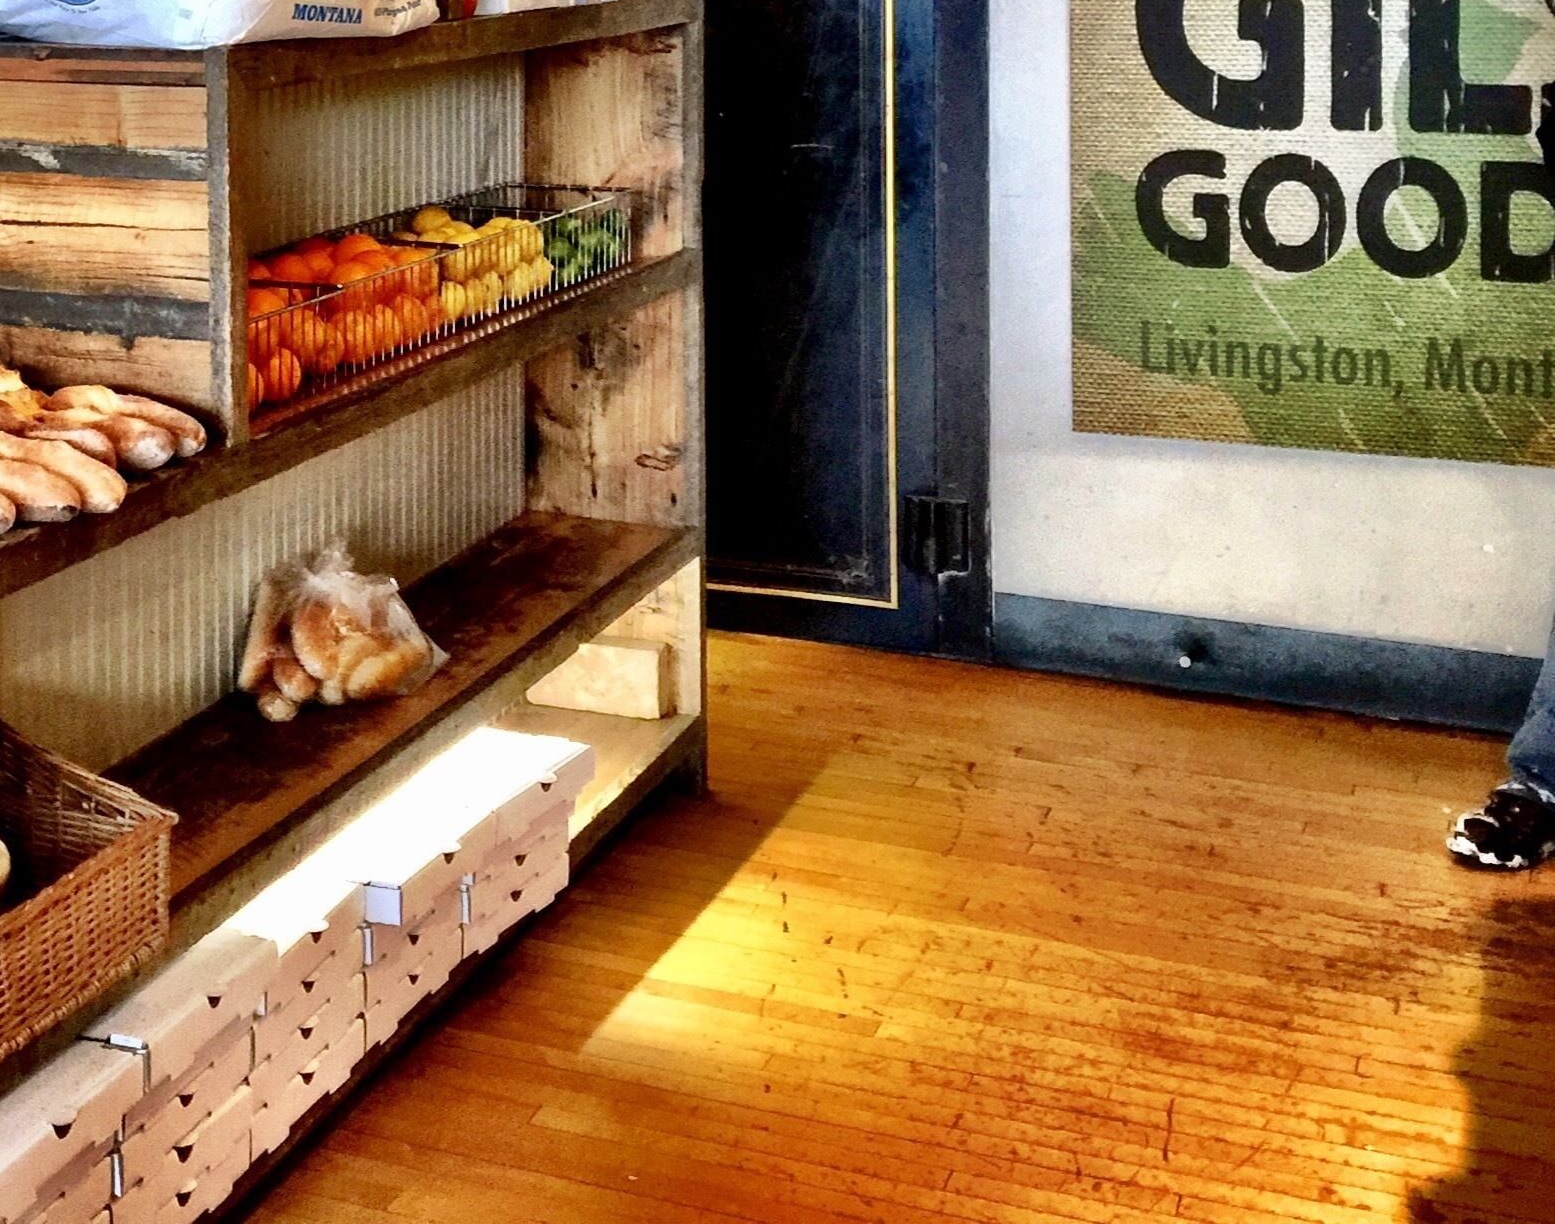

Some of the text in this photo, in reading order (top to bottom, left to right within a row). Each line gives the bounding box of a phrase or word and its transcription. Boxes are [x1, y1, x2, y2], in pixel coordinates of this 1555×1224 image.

[291, 3, 363, 24] MONTANA
[1141, 320, 1555, 398] Livingston, Mont
